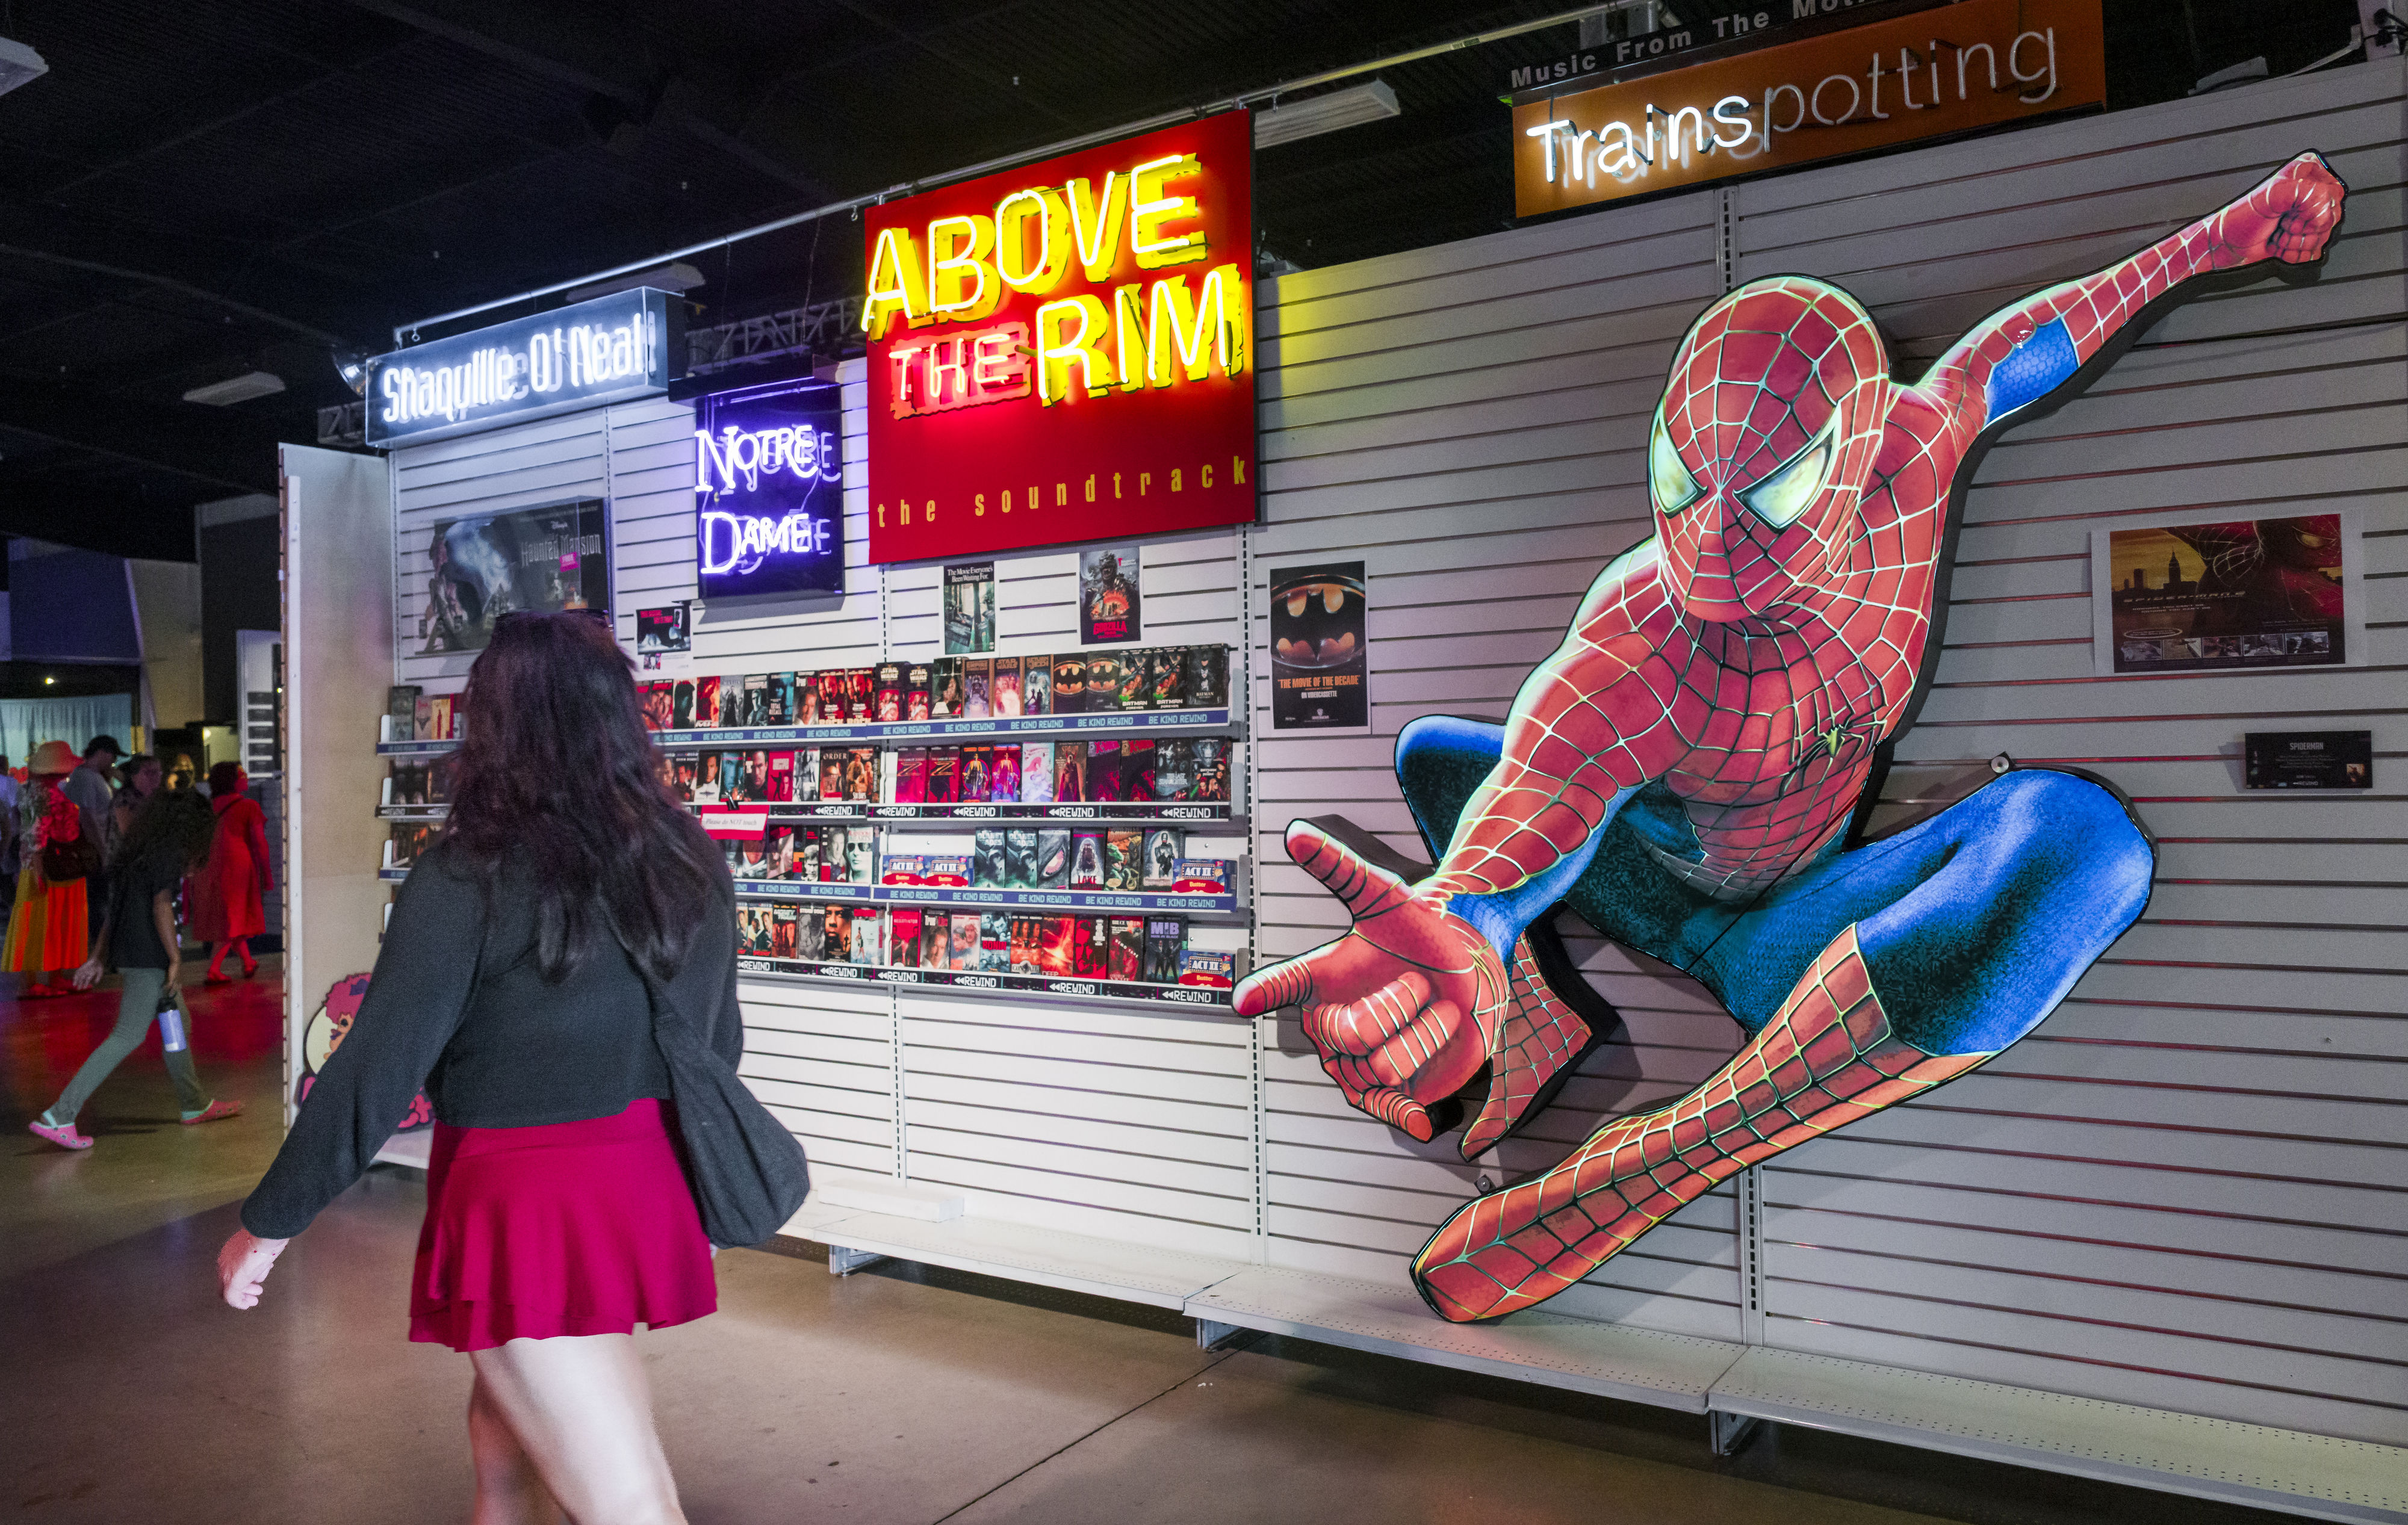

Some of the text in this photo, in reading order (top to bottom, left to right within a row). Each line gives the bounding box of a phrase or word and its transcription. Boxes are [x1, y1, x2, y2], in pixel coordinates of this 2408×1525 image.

[1511, 54, 1596, 88] Music
[1616, 29, 1691, 61] From
[1712, 11, 1769, 38] The
[1527, 27, 2056, 184] Trainspotting
[860, 153, 1210, 342] ABOVE
[889, 263, 1244, 420] THE RIM
[530, 312, 647, 392] O'Neal
[877, 456, 1246, 528] the soundtrack
[1093, 620, 1128, 635] GODZILLA
[1292, 677, 1312, 688] MOVIE
[1313, 676, 1321, 687] OF
[1322, 676, 1333, 686] THE
[1078, 717, 1134, 728] BE KIND REWIND
[1149, 714, 1208, 725] BE KIND REWIND
[883, 725, 931, 735] BE KIND REWIND
[945, 722, 996, 732] BE KIND REWIND
[1011, 720, 1064, 730] BE KIND REWIND
[815, 729, 829, 738] KIND
[830, 729, 851, 737] REWIND
[2289, 742, 2324, 750] SPIDERMAN
[824, 806, 852, 815] REWIND
[885, 807, 916, 817] REWIND
[963, 807, 996, 817] REWIND
[1059, 807, 1094, 817] REWIND
[1173, 808, 1211, 818] REWIND
[892, 862, 914, 871] ACT II
[1185, 867, 1211, 876] ACT II
[819, 886, 833, 895] KIND
[834, 887, 855, 896] REWIND
[890, 890, 939, 900] BE KIND REWIND
[952, 892, 1004, 902] BE KIND REWIND
[1019, 894, 1072, 904] BE KIND REWIND
[1085, 896, 1141, 906] BE KIND REWIND
[1156, 898, 1216, 908] BE KIND REWIND
[982, 941, 1007, 951] RONIN
[744, 960, 771, 971] REWIND
[1191, 960, 1218, 971] ACT II
[828, 967, 857, 977] REWIND
[887, 971, 918, 982] REWIND
[964, 976, 997, 988] REWIND
[1060, 983, 1095, 995] REWIND
[1173, 991, 1211, 1003] REWIND
